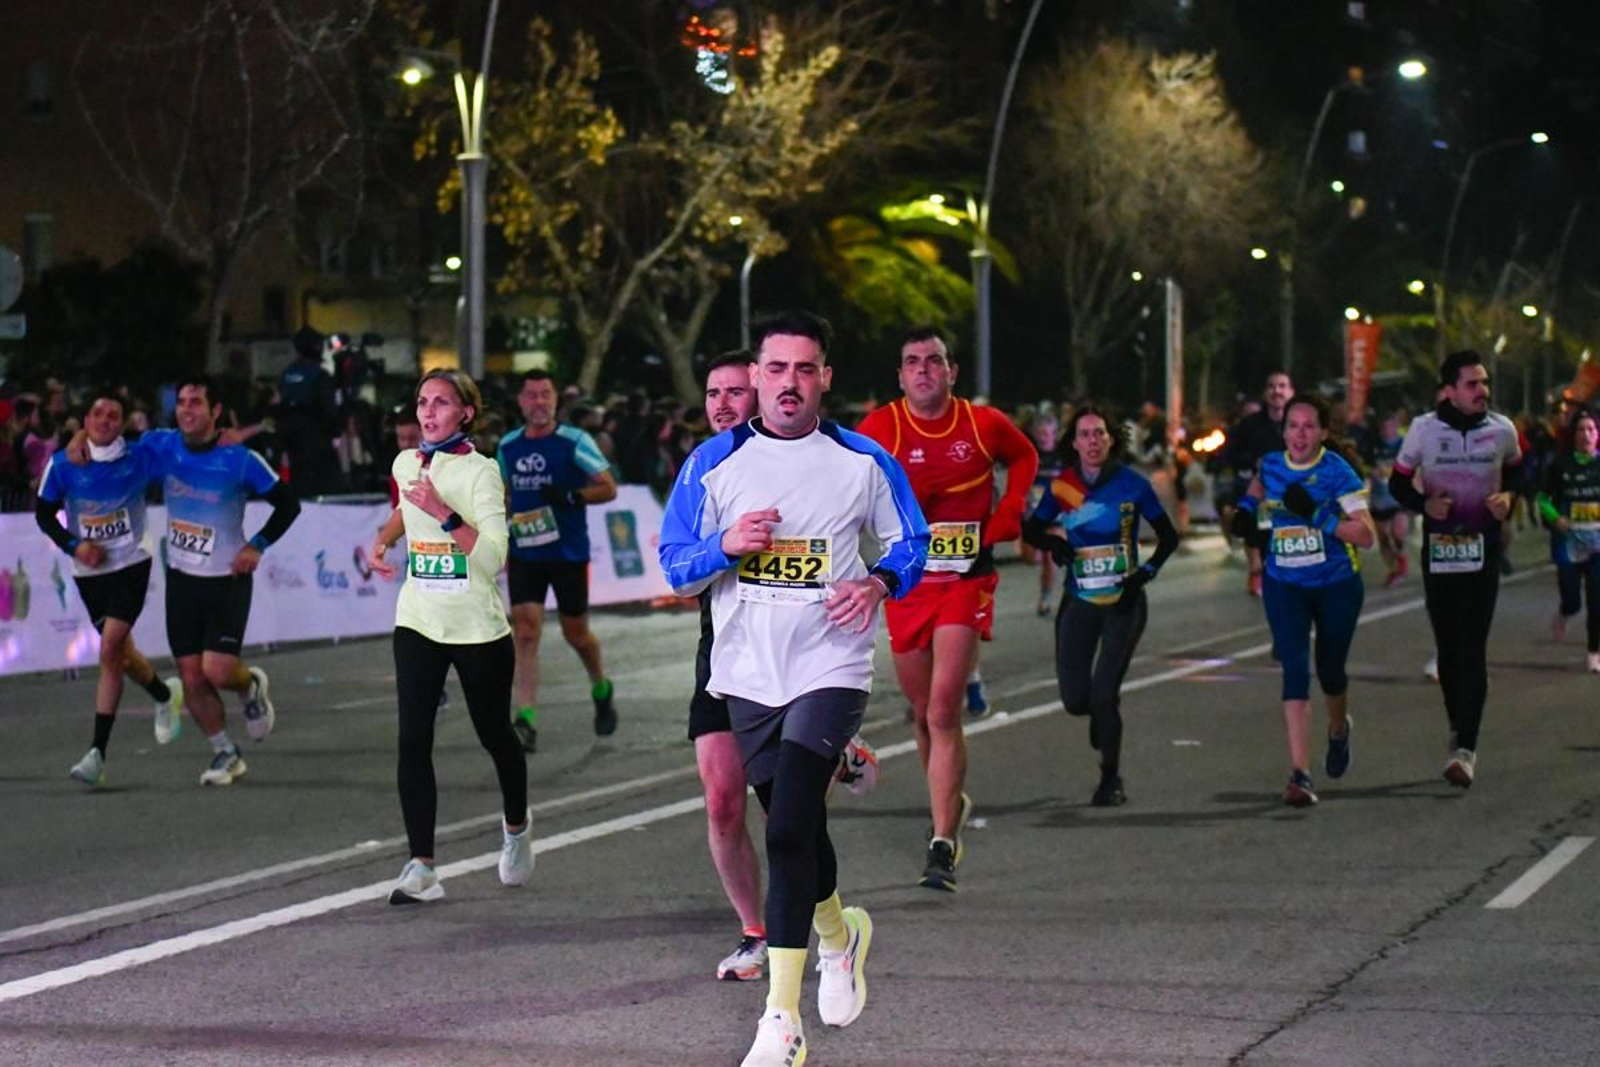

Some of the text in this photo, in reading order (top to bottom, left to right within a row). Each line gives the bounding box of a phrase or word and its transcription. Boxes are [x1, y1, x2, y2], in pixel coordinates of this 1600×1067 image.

[84, 521, 126, 541] 7509
[171, 528, 209, 550] 7927
[928, 537, 973, 554] 619
[1276, 536, 1318, 553] 1649
[1434, 543, 1479, 558] 3038
[416, 555, 455, 573] 879
[744, 556, 822, 580] 4452
[1083, 556, 1116, 573] 857
